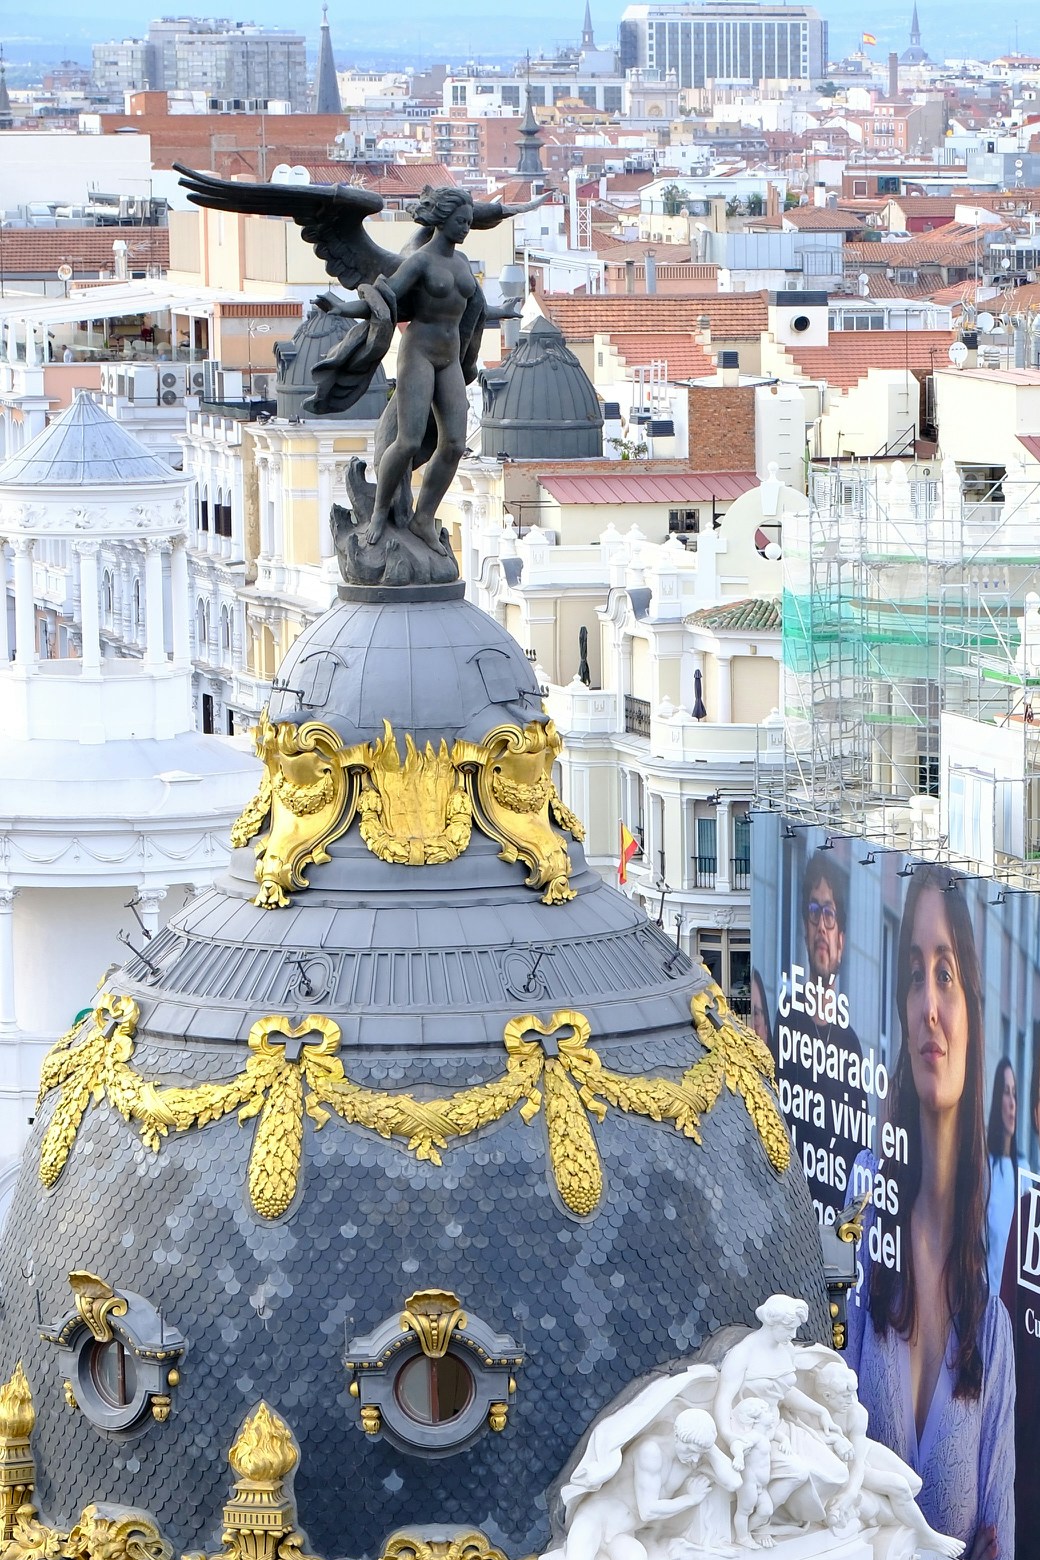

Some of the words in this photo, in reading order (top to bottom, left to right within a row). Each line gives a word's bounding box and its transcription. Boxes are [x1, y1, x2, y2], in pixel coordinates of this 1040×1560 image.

[778, 963, 850, 1030] ¿Estás
[778, 1024, 889, 1100] preparado
[778, 1078, 826, 1131] para
[831, 1093, 877, 1150] vivir
[882, 1121, 908, 1165] en
[803, 1138, 847, 1192] país
[854, 1159, 899, 1216] más
[869, 1217, 901, 1273] del
